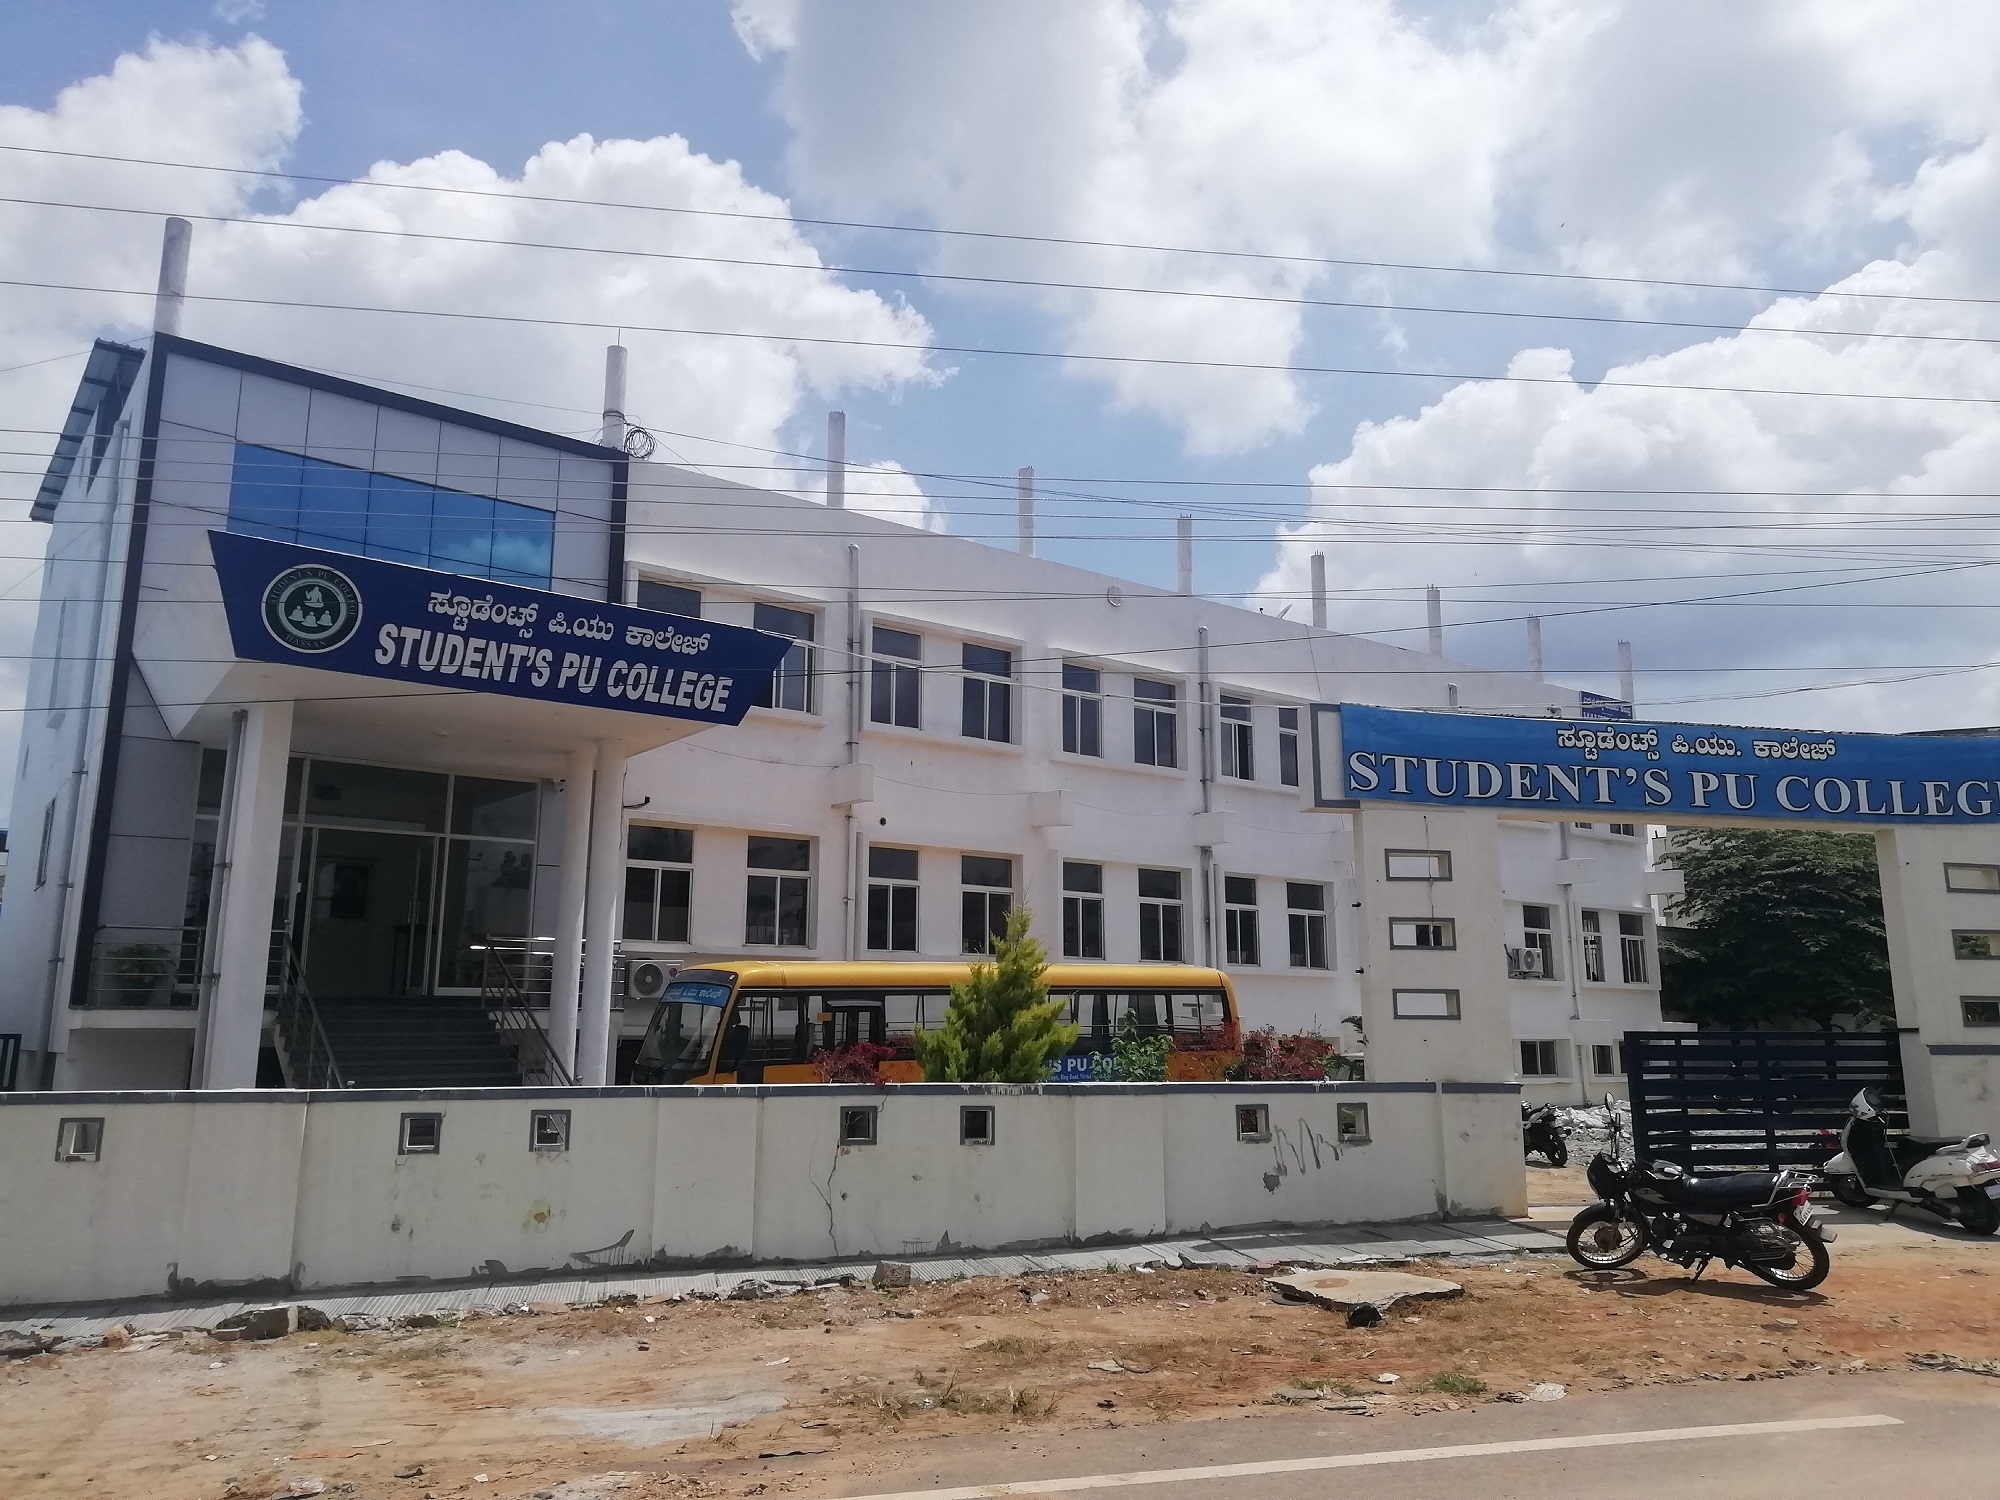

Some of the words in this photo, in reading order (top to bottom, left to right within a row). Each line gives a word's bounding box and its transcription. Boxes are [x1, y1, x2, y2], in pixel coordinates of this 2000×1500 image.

[625, 625, 711, 656] ಕಾಲೇಜ್
[374, 622, 553, 688] STUDENT'S
[557, 652, 603, 694] PU
[607, 659, 734, 713] COLLEGE
[1752, 736, 1837, 761] ಕಾಲೇಜ್
[1348, 752, 1674, 806] STUDENT'S
[1690, 771, 1758, 811] PU
[1775, 776, 2000, 817] COLLEG
[1067, 1058, 1088, 1073] PU
